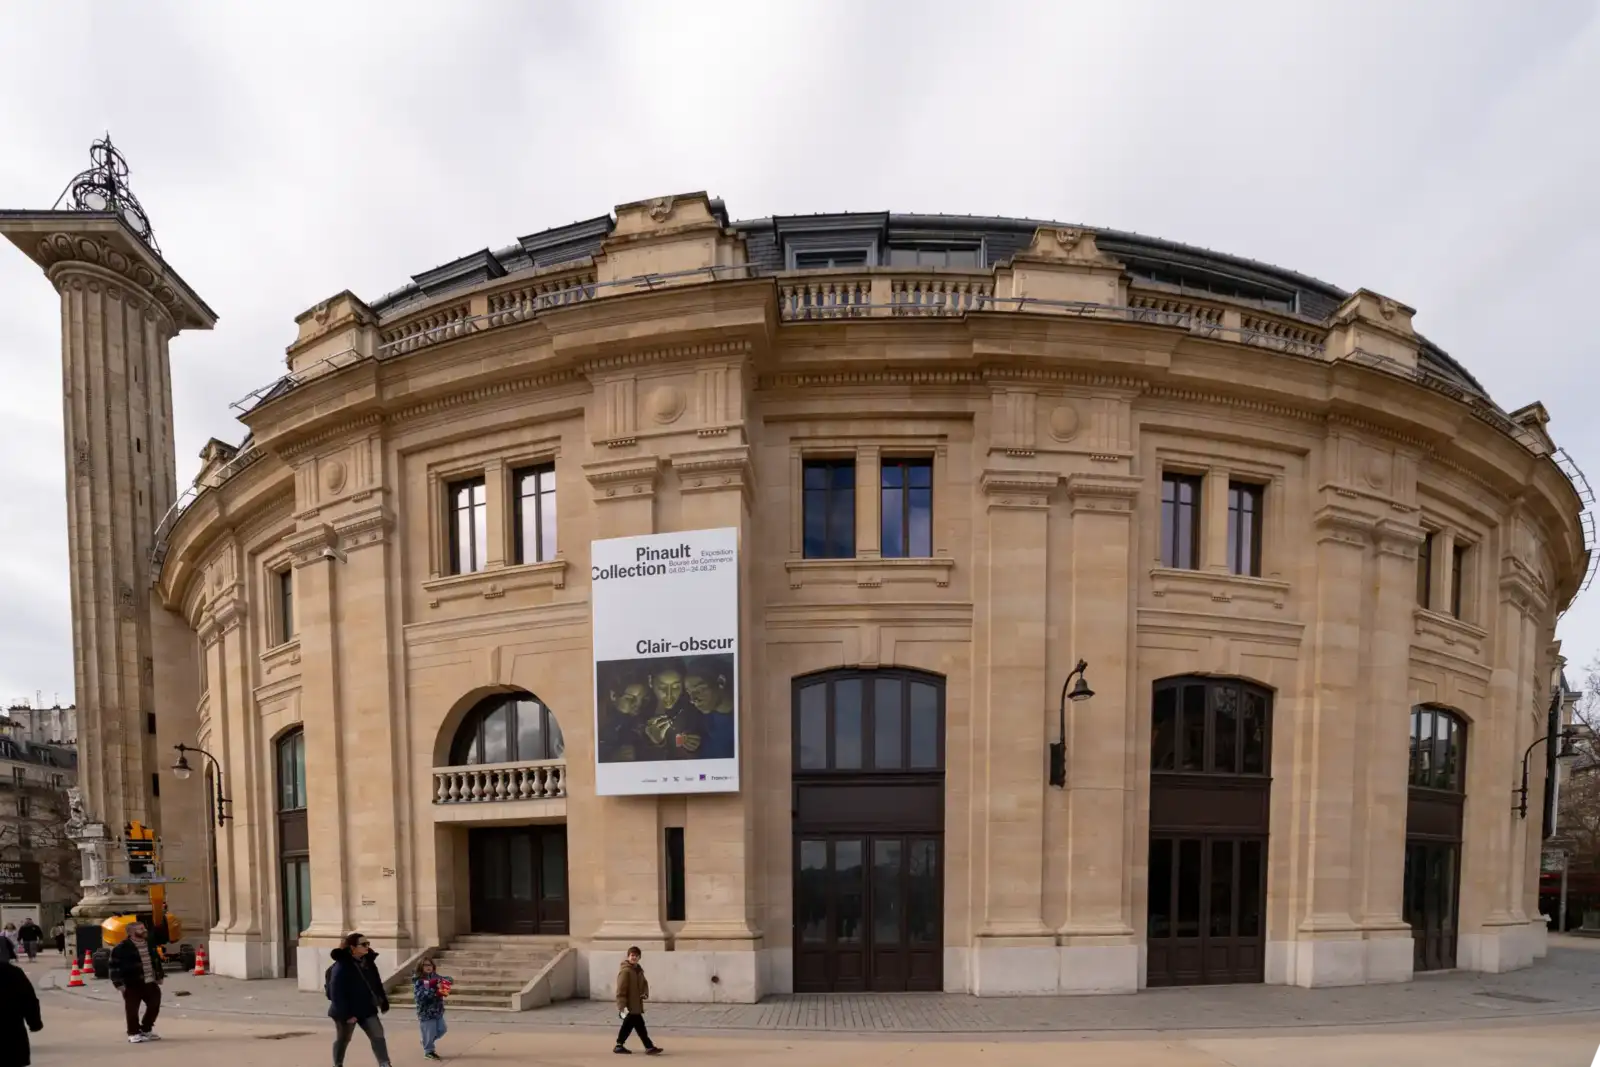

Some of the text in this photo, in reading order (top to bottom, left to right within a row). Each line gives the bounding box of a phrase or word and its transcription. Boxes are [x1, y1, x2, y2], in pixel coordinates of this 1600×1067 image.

[636, 543, 691, 562] Pinault
[701, 549, 734, 557] Exposition
[668, 559, 689, 567] Bourse
[700, 556, 734, 565] Commerce
[591, 562, 666, 581] Collection
